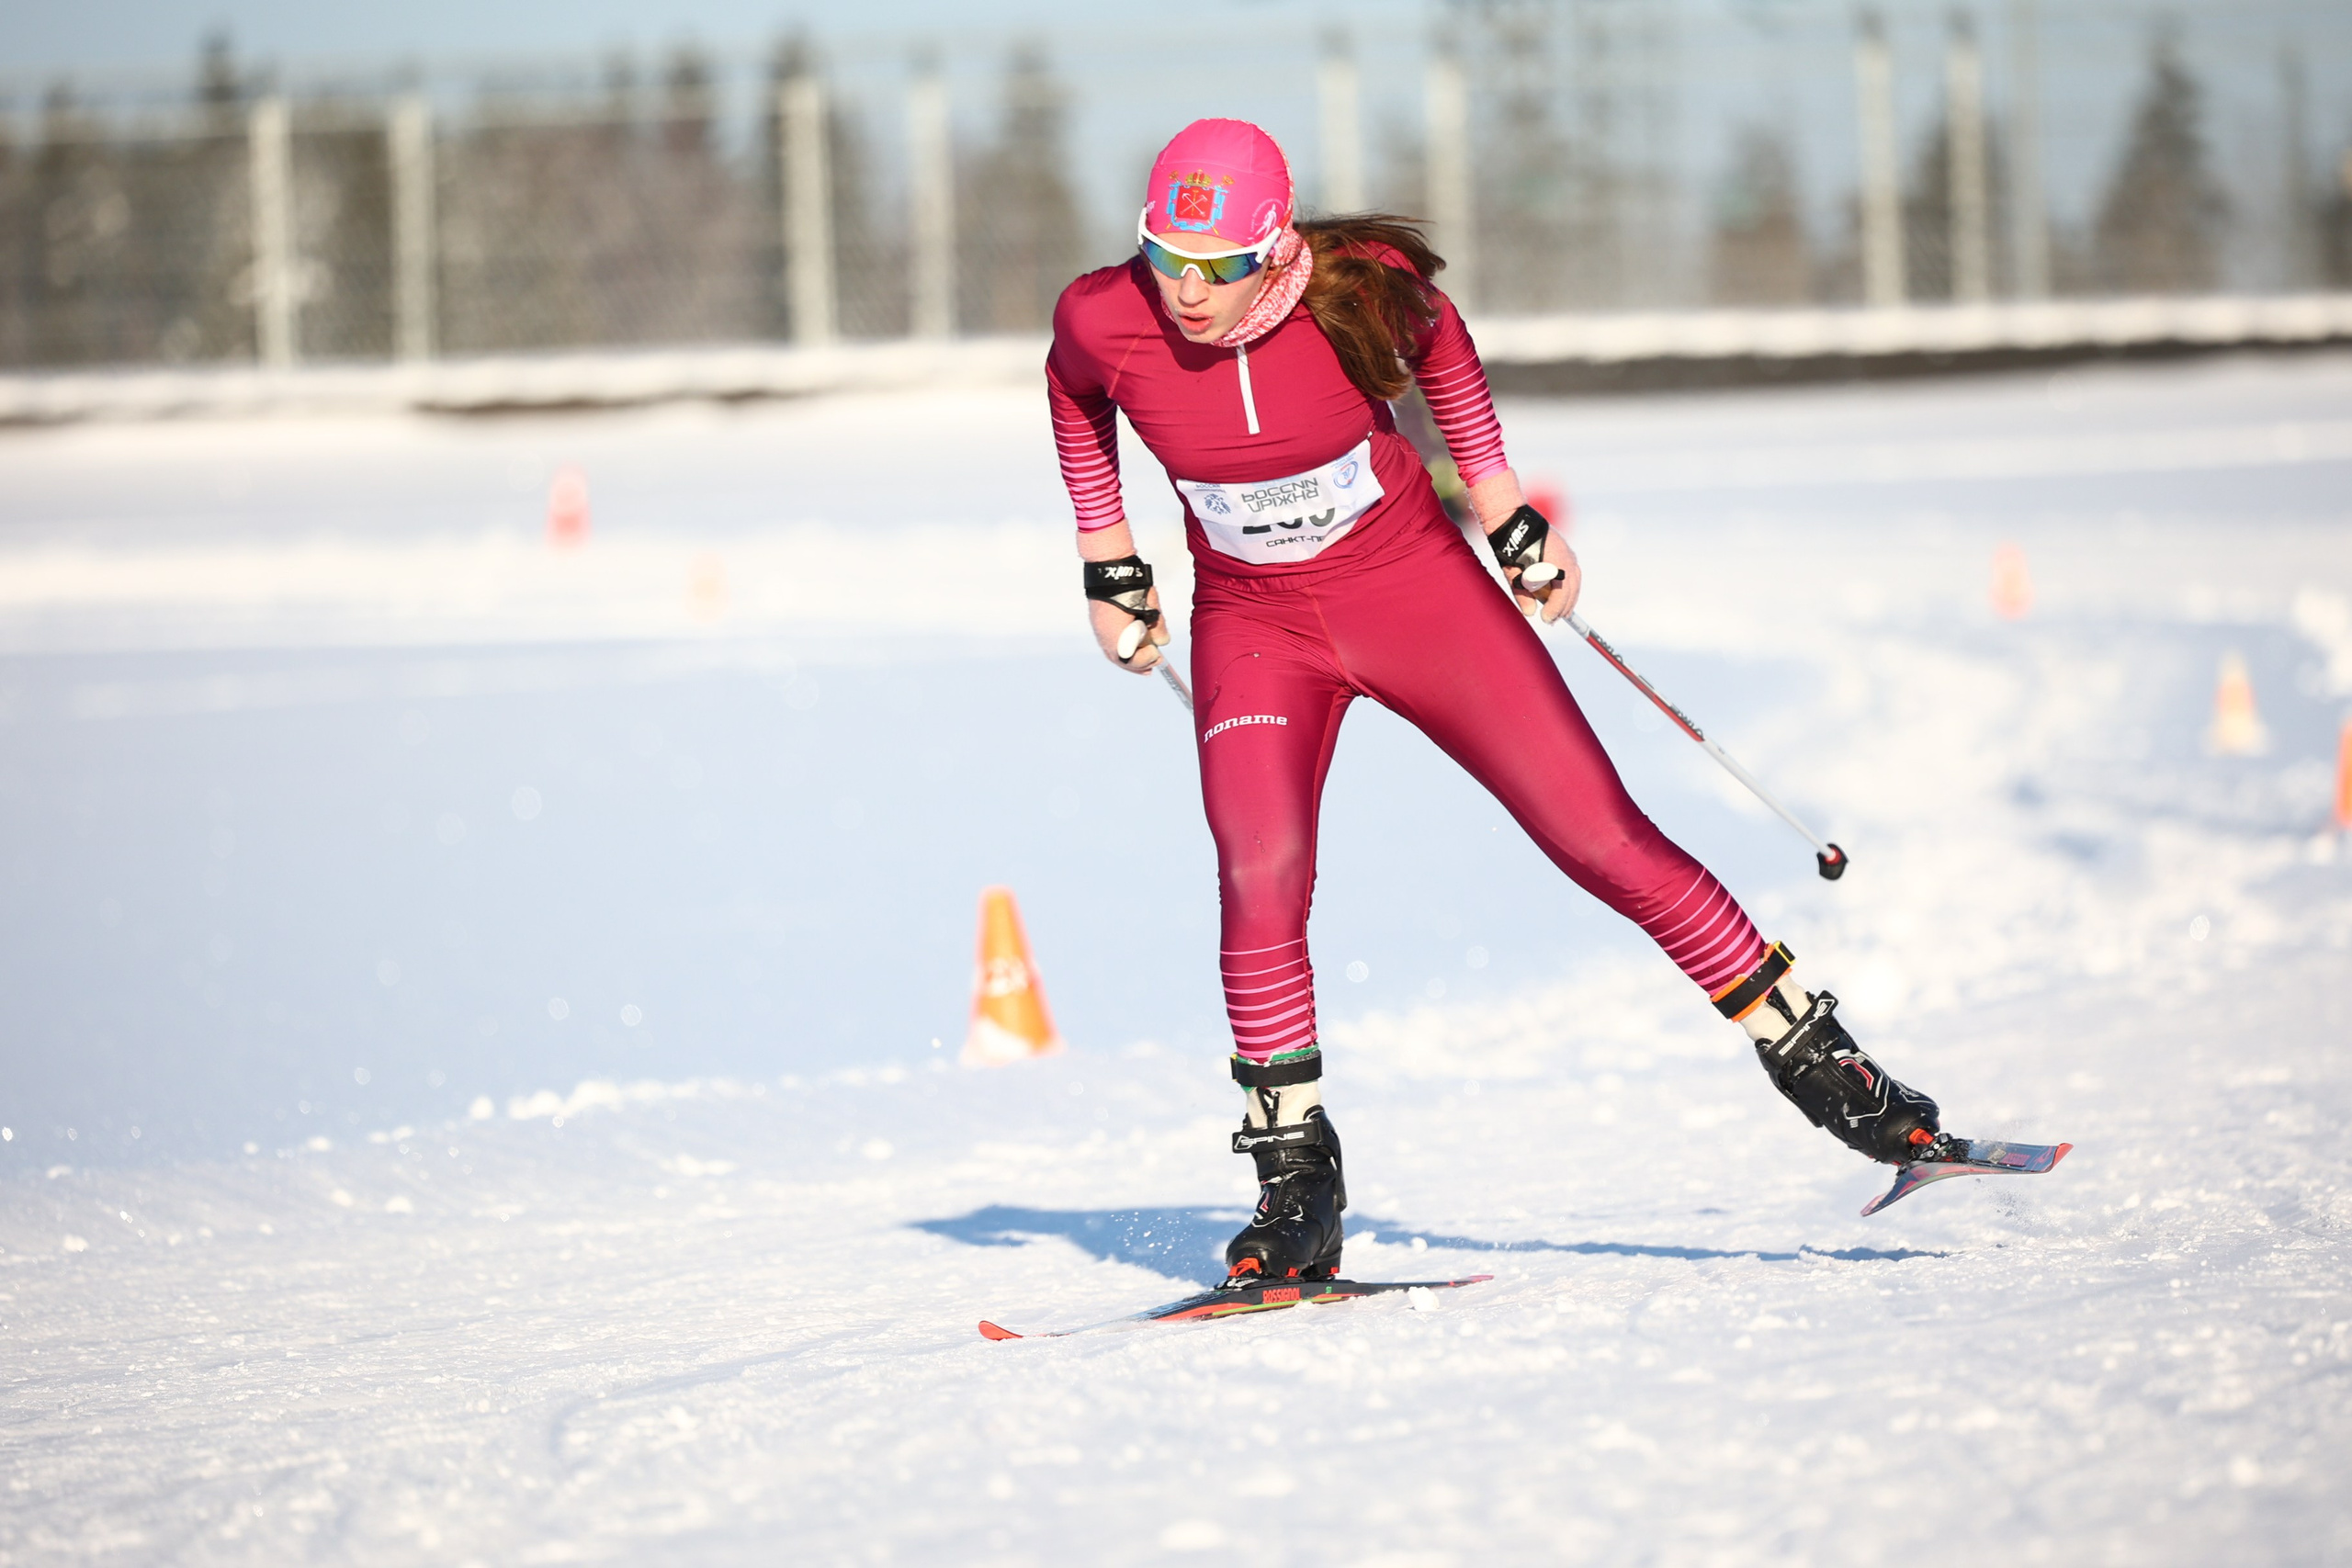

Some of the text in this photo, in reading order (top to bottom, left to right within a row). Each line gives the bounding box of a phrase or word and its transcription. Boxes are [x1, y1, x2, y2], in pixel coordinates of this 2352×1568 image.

[1204, 715, 1288, 743] noname
[1778, 1001, 1828, 1056] SPINE
[1240, 1131, 1306, 1145] SPINE
